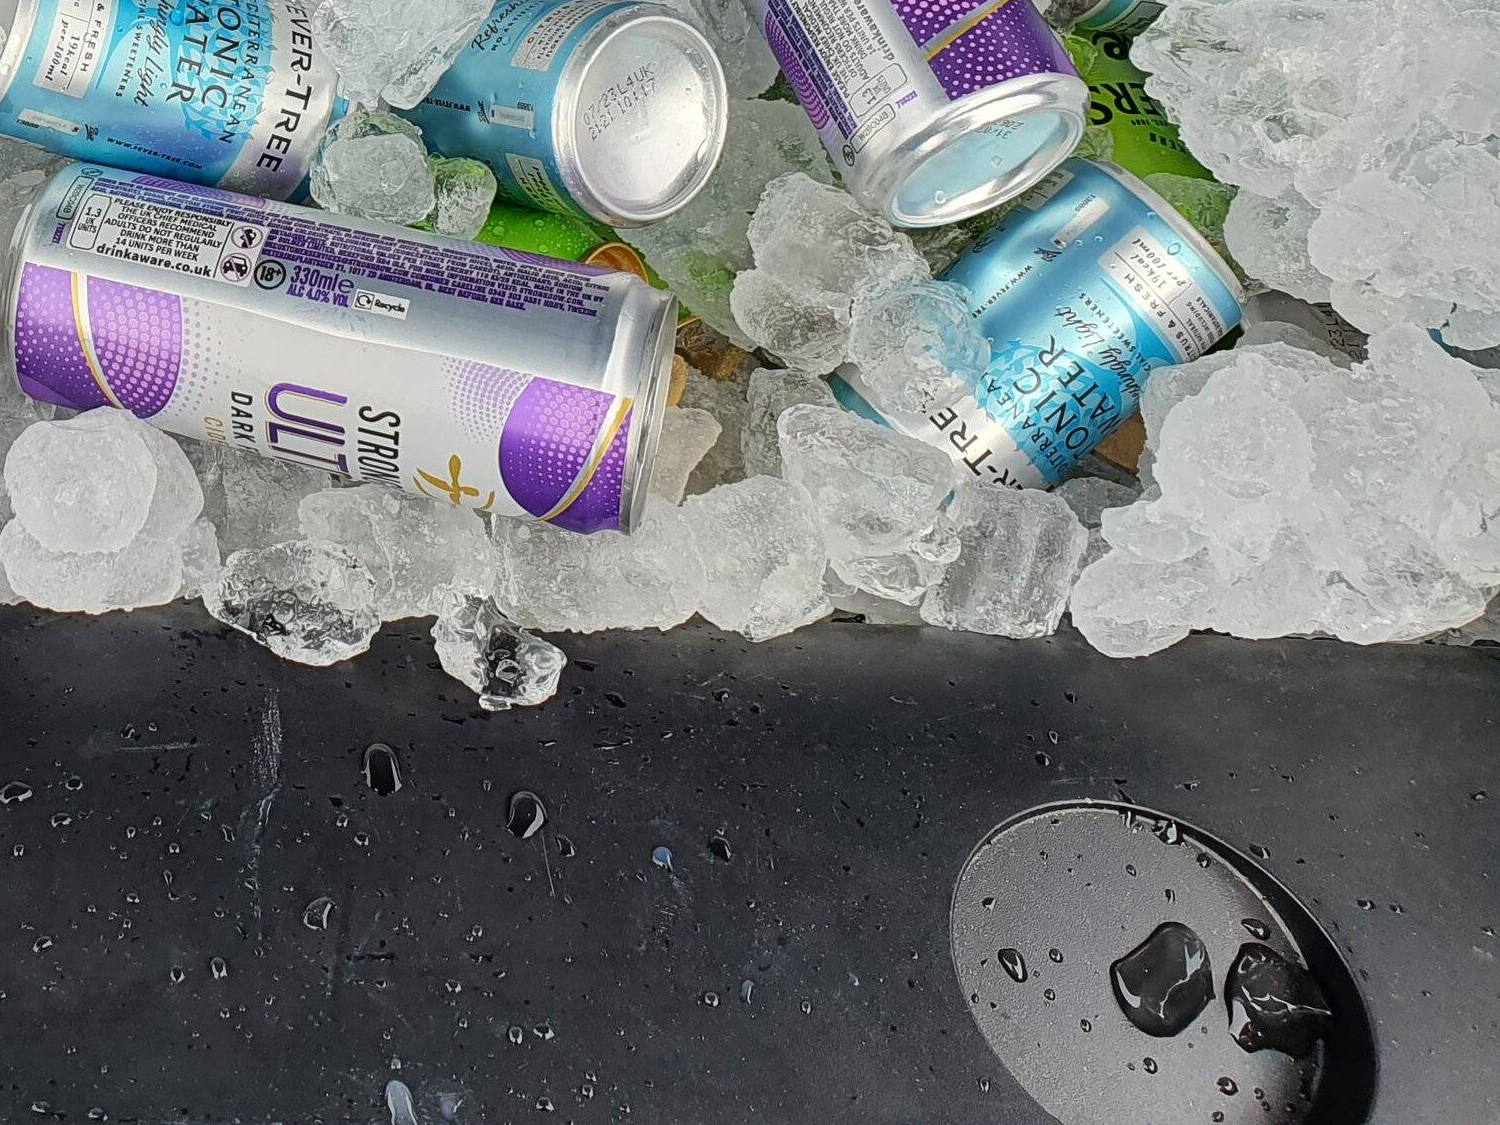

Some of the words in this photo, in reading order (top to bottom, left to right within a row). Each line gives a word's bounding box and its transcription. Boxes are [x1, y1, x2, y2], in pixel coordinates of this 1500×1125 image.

[97, 3, 105, 12] &
[60, 35, 80, 76] 19kcal
[80, 20, 102, 72] FRESH
[115, 25, 143, 98] SWEETENERS
[134, 57, 164, 107] Light
[256, 3, 313, 173] EVER-TREE
[85, 207, 102, 218] 1.3
[85, 217, 95, 225] UK
[114, 198, 145, 209] PLEASE
[151, 204, 173, 215] ENJOY
[174, 210, 231, 227] RESPONSIBLY
[118, 213, 157, 226] OFFICERS
[159, 222, 215, 238] RECOMMEND
[122, 206, 138, 216] THE
[140, 209, 152, 218] UK
[153, 211, 179, 223] CHIEF
[179, 217, 218, 232] MEDICAL
[78, 224, 97, 233] UNITS
[104, 218, 137, 231] ADULTS
[138, 225, 152, 233] DO
[153, 227, 172, 236] NOT
[173, 232, 223, 248] REGULARLY
[120, 230, 147, 241] DRINK
[148, 236, 174, 247] MORE
[176, 241, 200, 252] THAN
[96, 243, 212, 277] drinkaware.co.uk
[115, 237, 127, 245] 14
[128, 240, 154, 251] UNITS
[155, 246, 172, 255] PER
[174, 249, 199, 262] WEEK
[260, 265, 282, 282] 18+
[286, 284, 304, 297] ALC
[306, 288, 331, 304] 4.0%
[332, 293, 349, 308] VOL
[374, 299, 406, 313] Recycle
[1124, 274, 1166, 317] FRESH
[1054, 306, 1105, 349] Light
[1079, 292, 1136, 353] SWEETENERS
[230, 391, 256, 445] DARK
